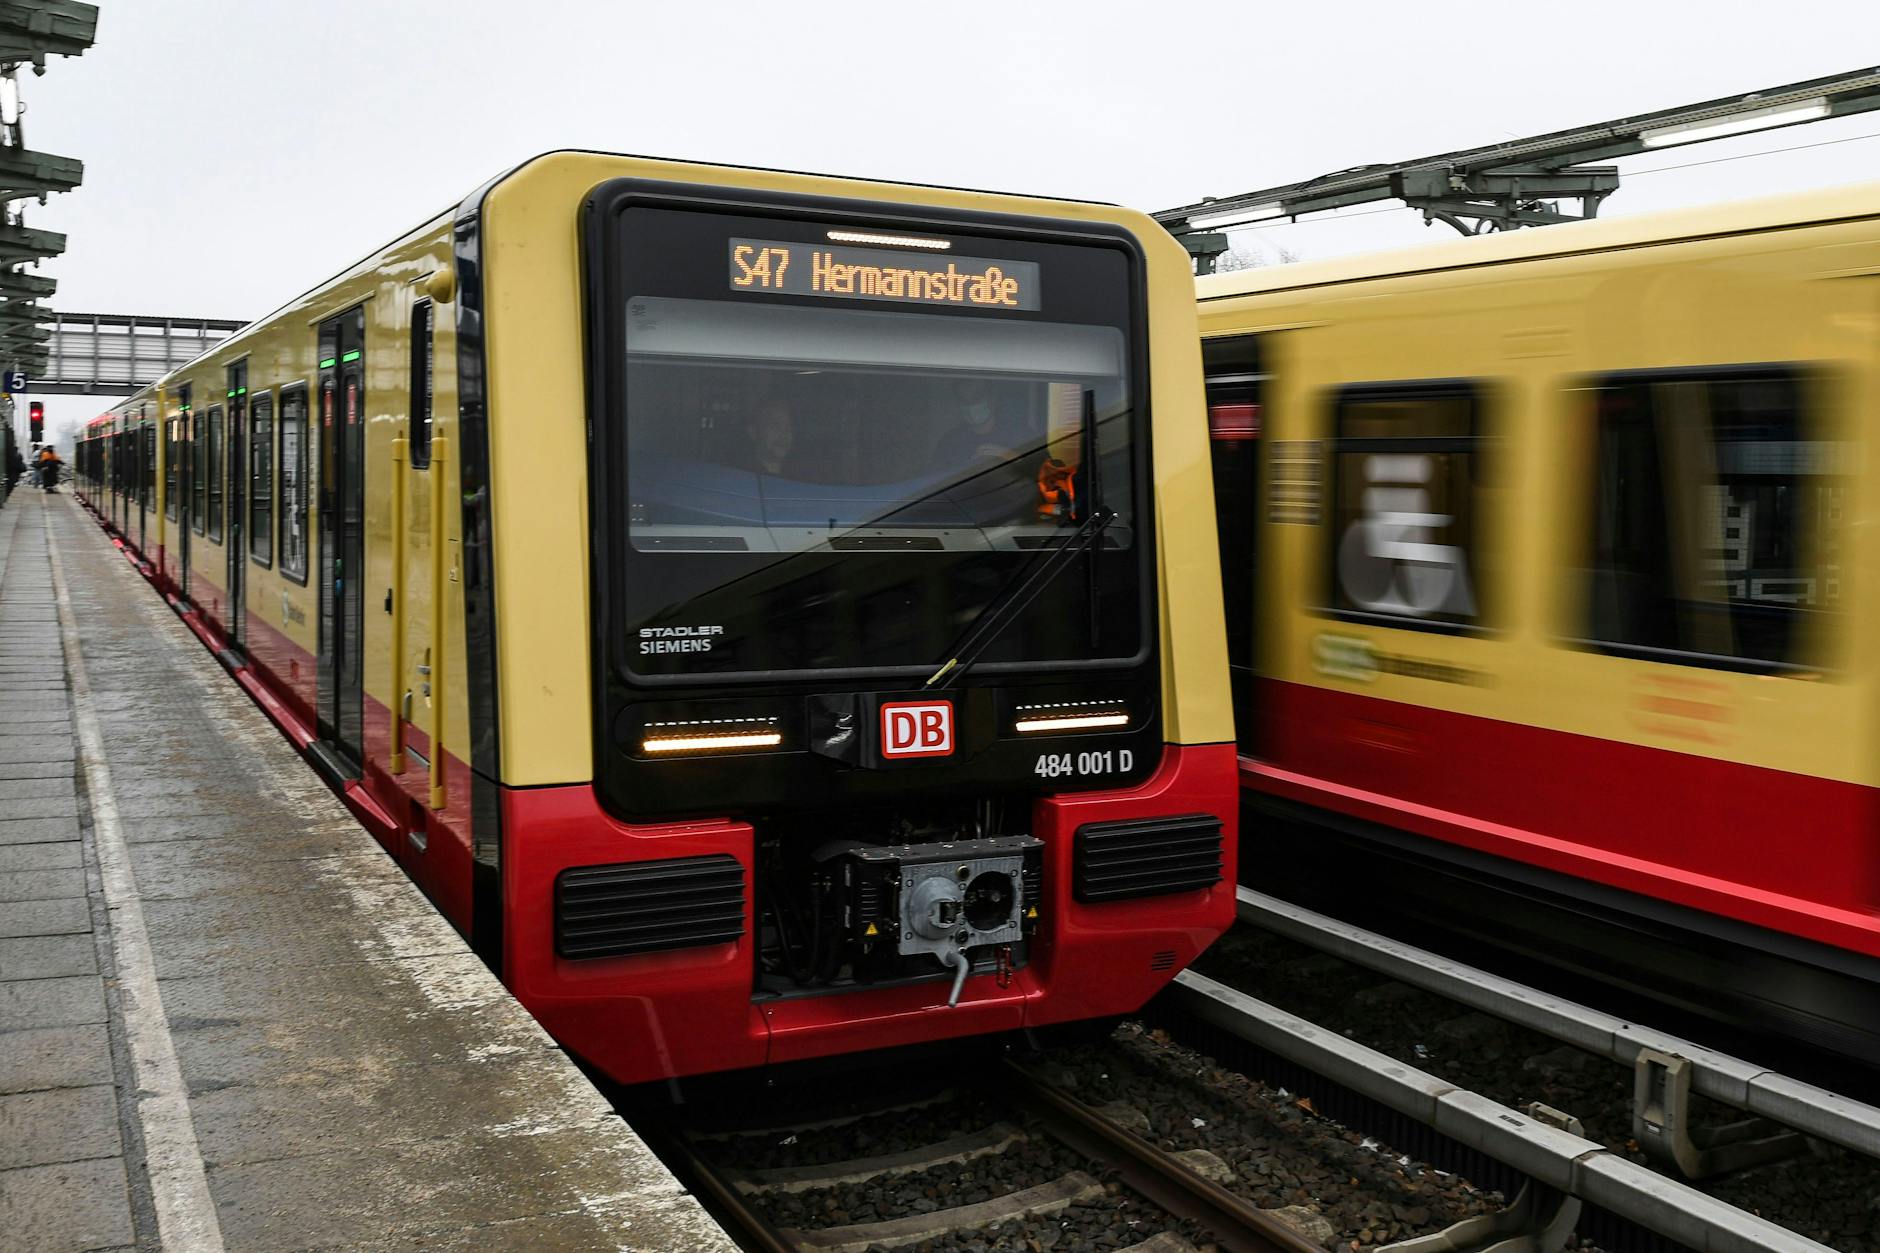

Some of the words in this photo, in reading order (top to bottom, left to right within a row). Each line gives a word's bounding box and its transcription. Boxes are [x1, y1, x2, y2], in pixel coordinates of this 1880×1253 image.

[734, 245, 790, 288] S47
[812, 252, 1018, 305] Hermannstraße
[11, 372, 26, 390] 5
[639, 625, 724, 638] STADLER
[639, 639, 712, 655] SIEMENS
[890, 709, 946, 750] DB
[1034, 753, 1073, 778] 484
[1077, 750, 1113, 774] 001
[1119, 749, 1134, 772] D
